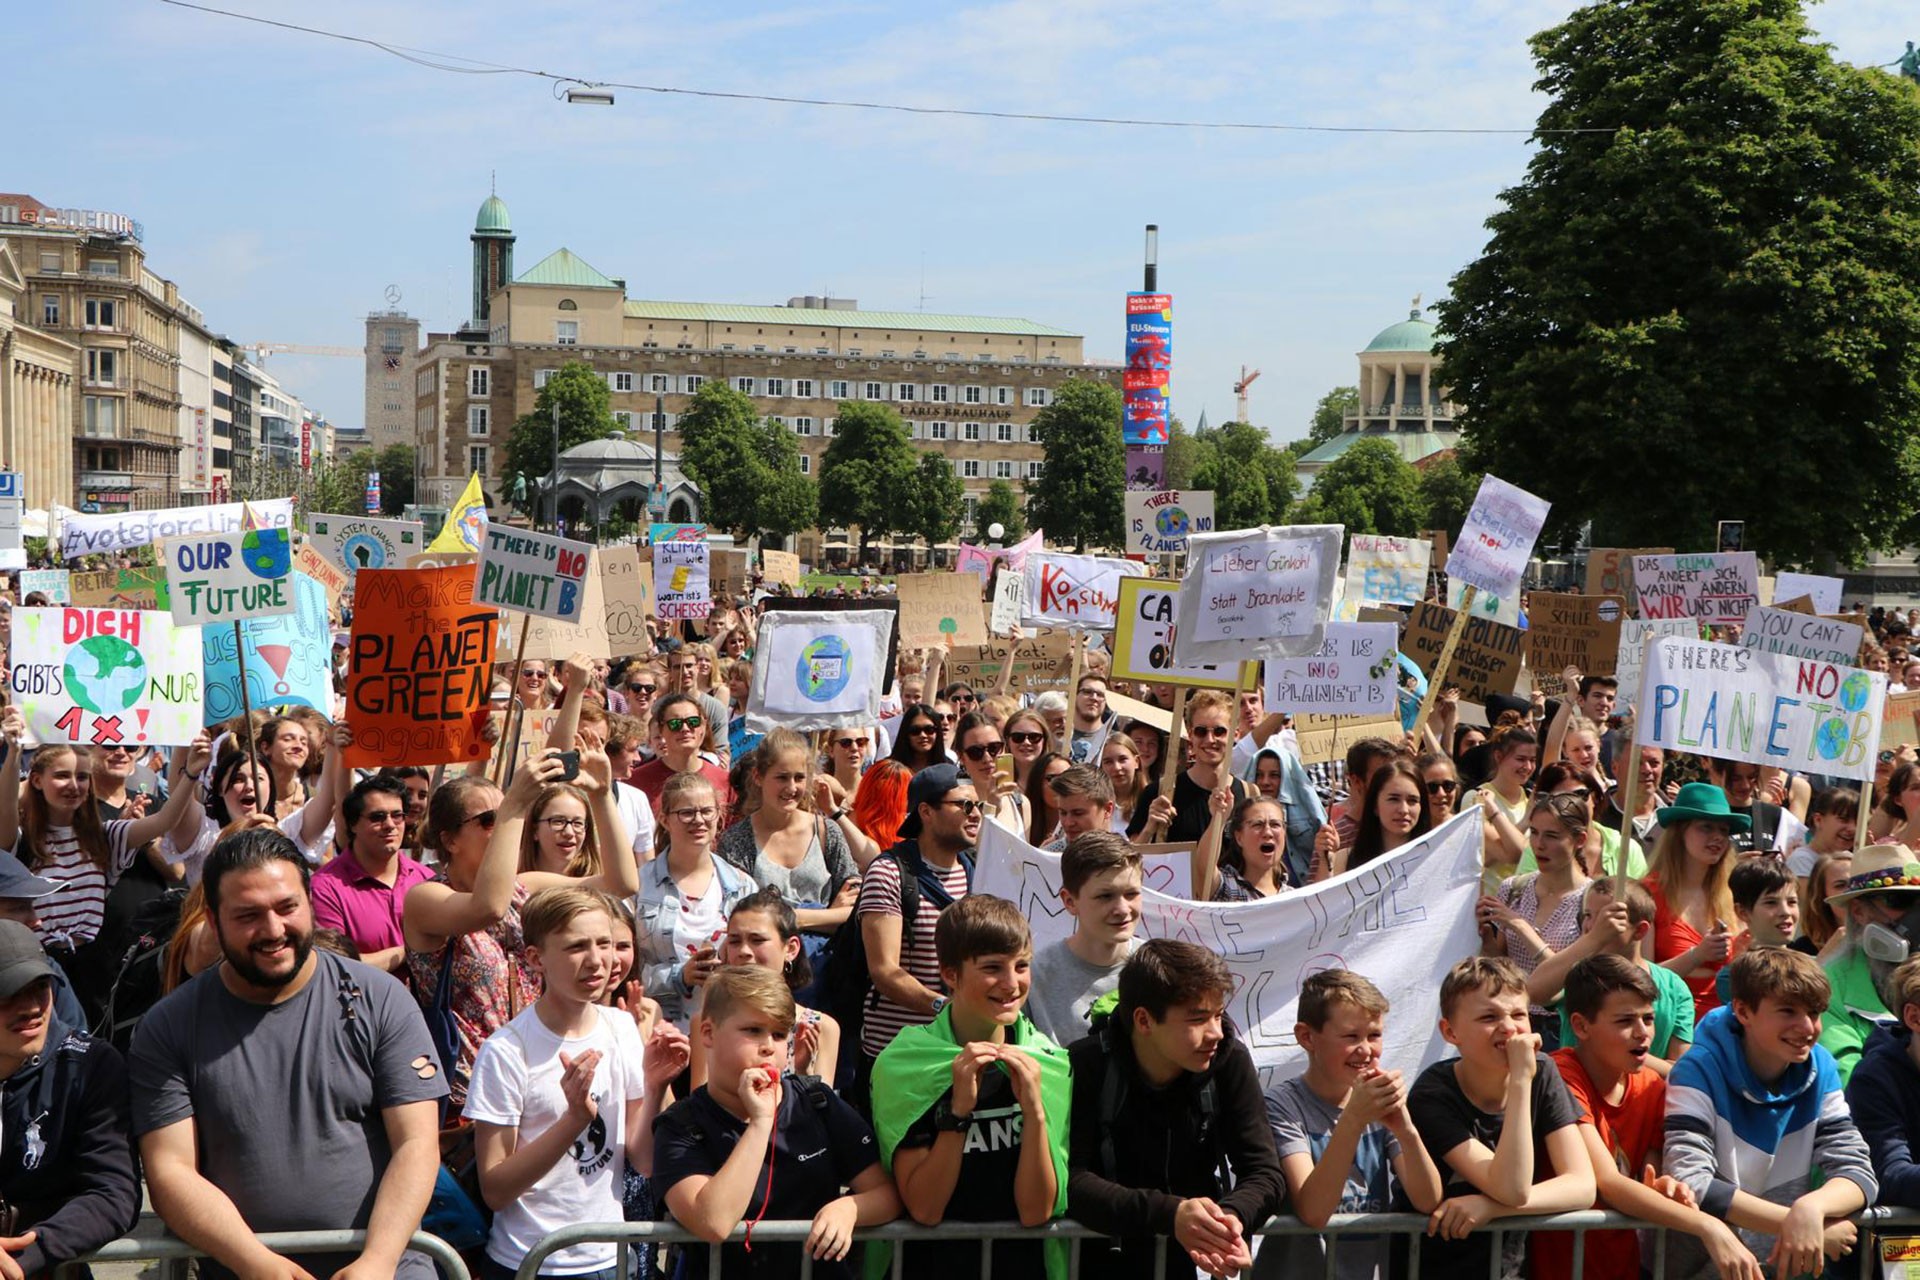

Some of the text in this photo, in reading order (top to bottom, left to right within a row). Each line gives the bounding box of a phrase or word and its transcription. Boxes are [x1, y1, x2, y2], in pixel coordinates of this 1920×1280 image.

[901, 406, 1011, 419] CARLS BRAUHAUS
[1143, 492, 1180, 509] THERE
[1133, 517, 1212, 532] IS NO
[334, 523, 397, 559] SYSTEM CHANGE
[663, 543, 704, 554] KLIMA
[1140, 534, 1187, 551] PLANET
[1479, 532, 1501, 550] not
[177, 542, 232, 573] OUR
[488, 531, 587, 578] THERE IS NO
[662, 555, 703, 564] ist wie
[1211, 553, 1261, 573] Lieber
[1638, 556, 1715, 571] DAS KLIMA
[75, 575, 92, 593] BE
[359, 569, 475, 609] Make
[480, 560, 578, 615] PLANET B
[1636, 584, 1687, 597] WARUM
[180, 579, 287, 616] FUTURE
[657, 593, 684, 601] warm
[1246, 586, 1306, 609] Braunkohle
[1640, 595, 1687, 618] WIR
[1688, 599, 1714, 616] UNS
[658, 602, 709, 618] SCHEISSE
[1551, 609, 1591, 626] SCHULE
[63, 608, 140, 646] DICH
[404, 610, 450, 634] the
[1418, 605, 1526, 656] KLIMPOLITIK
[1760, 610, 1845, 644] YOU CAN'T
[353, 613, 498, 674] PLANET
[1351, 638, 1373, 657] IS
[1032, 658, 1056, 671] wie
[1307, 662, 1340, 680] NO
[12, 664, 199, 703] GIBTS NUR
[1796, 661, 1839, 699] NO
[353, 663, 494, 722] GREEN
[1277, 682, 1385, 704] PLANET B
[1653, 684, 1873, 766] PLANET B
[579, 1148, 614, 1176] FUTURE
